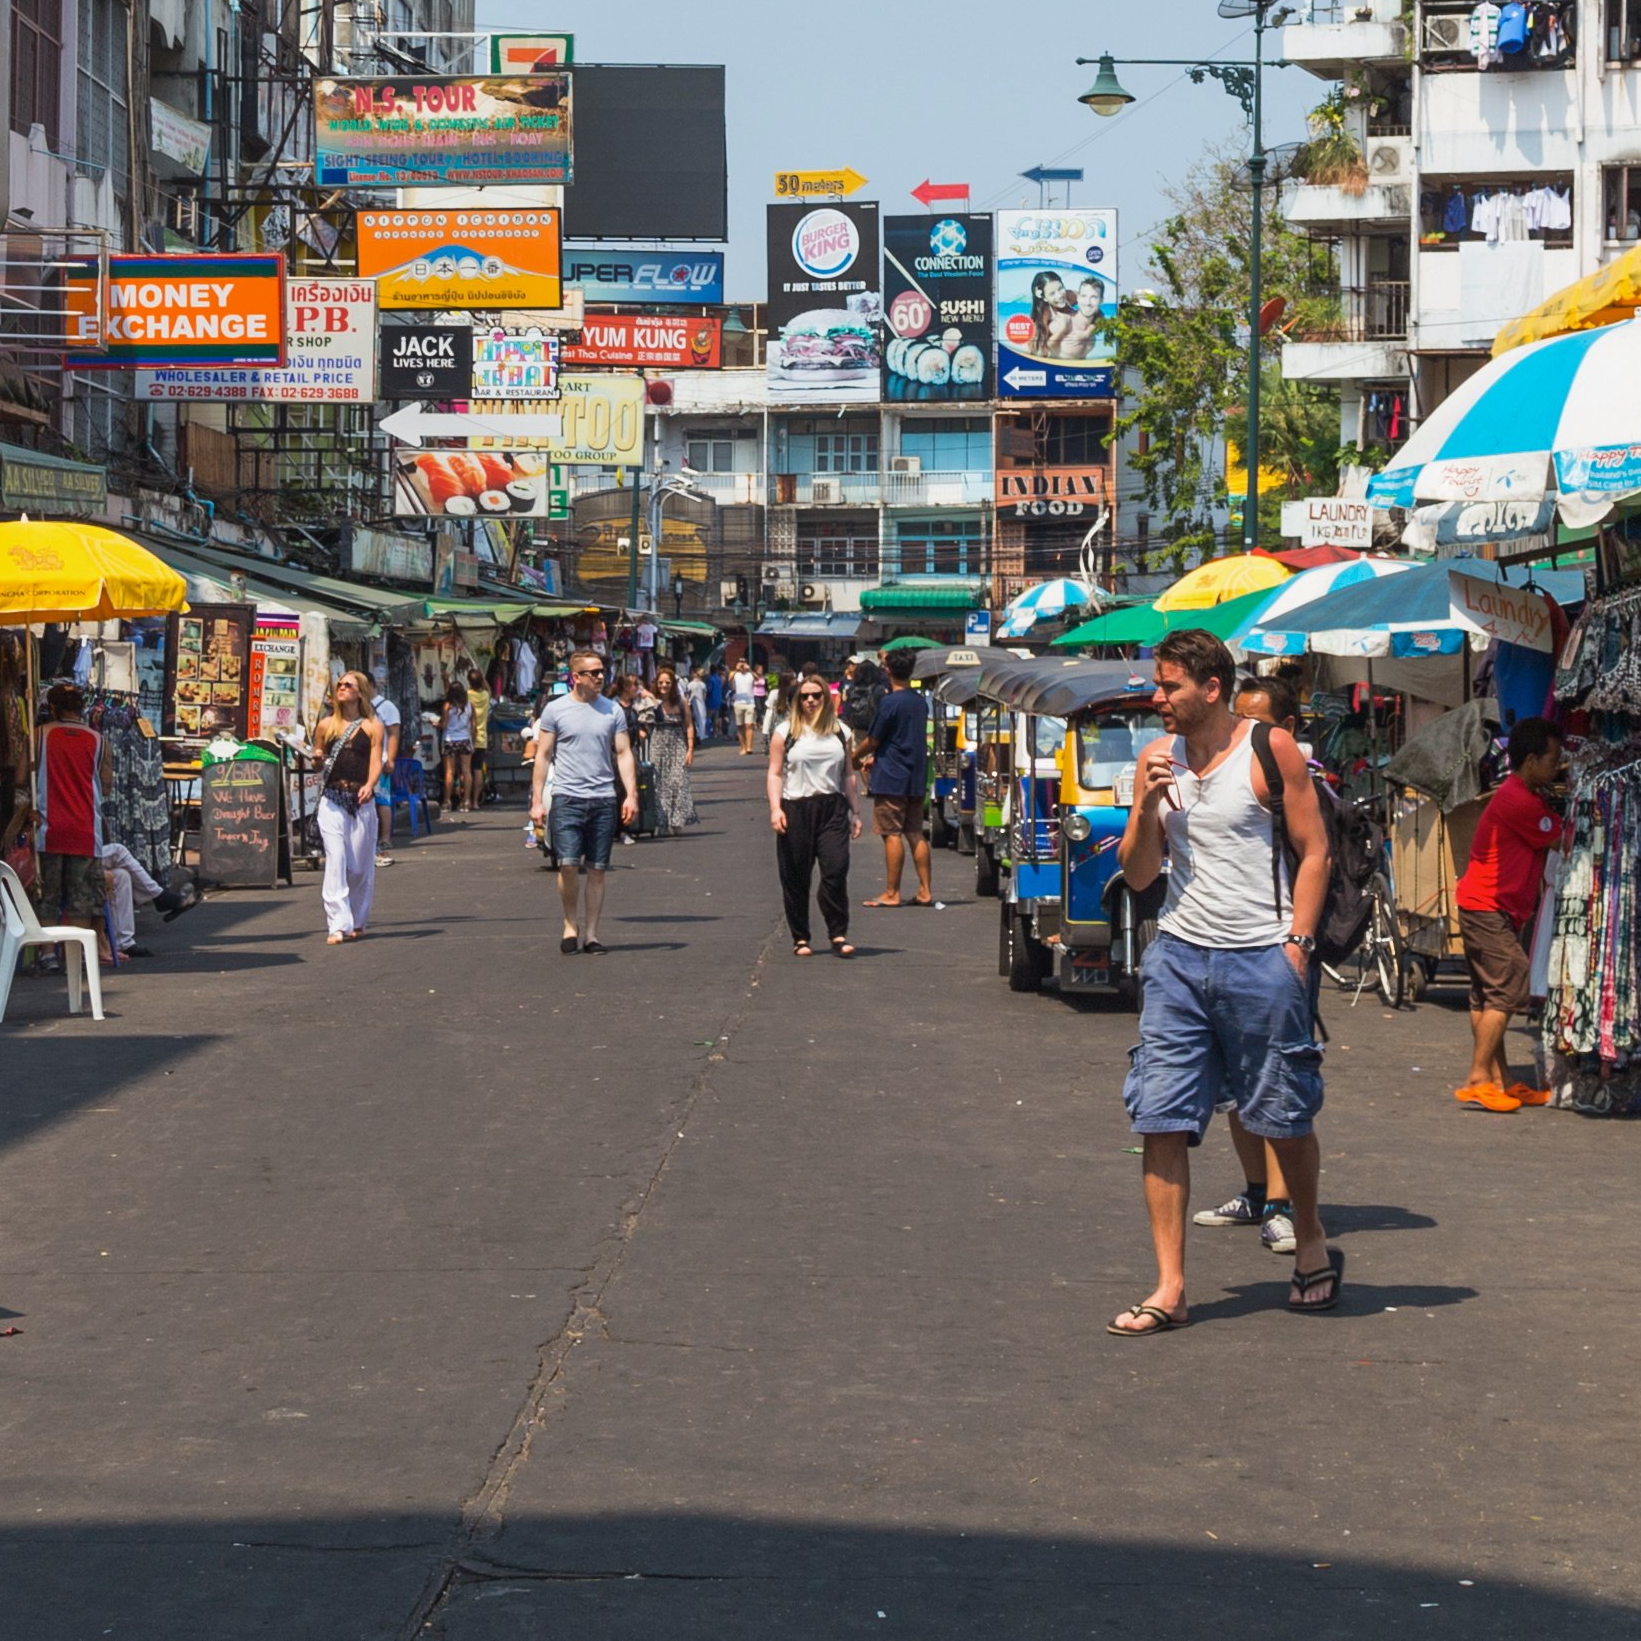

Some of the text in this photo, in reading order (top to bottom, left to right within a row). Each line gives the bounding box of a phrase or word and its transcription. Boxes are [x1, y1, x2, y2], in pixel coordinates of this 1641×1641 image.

[354, 85, 477, 114] N.S. TOUR
[519, 115, 559, 129] TICKET
[325, 154, 446, 167] SIGHT SEEING TOUR
[348, 170, 376, 182] License
[379, 171, 392, 182] No.
[778, 175, 845, 194] 50 meters
[364, 213, 552, 227] NIPPON ICHIBAN
[802, 222, 848, 246] BURGER
[804, 234, 850, 262] KING
[914, 256, 984, 270] CONNECTION
[783, 281, 866, 292] IT JUST TASTES BETTER
[110, 283, 235, 308] MONEY
[940, 300, 984, 314] SUSHI
[941, 315, 958, 323] NEW
[78, 314, 267, 339] EXCHANGE
[297, 337, 332, 347] SHOP
[583, 327, 687, 349] YUM KUNG
[392, 336, 455, 357] JACK
[577, 349, 633, 360] Thai Cuisine
[393, 358, 455, 368] LIVES HERE
[155, 370, 354, 384] WHOLESALER & RETAIL PRICE
[575, 451, 616, 461] GROUP
[1579, 449, 1628, 467] Happy
[1442, 465, 1480, 479] Happy
[5, 465, 56, 496] AA SILVER
[1001, 476, 1098, 496] INDIAN
[1441, 476, 1483, 486] Tourist
[1015, 500, 1084, 516] FOOD
[1309, 503, 1368, 522] LAUNDRY
[28, 589, 86, 597] CORPORATION
[1464, 579, 1550, 638] Laundry
[254, 644, 296, 654] EXCHANGE
[212, 790, 266, 803] We Have
